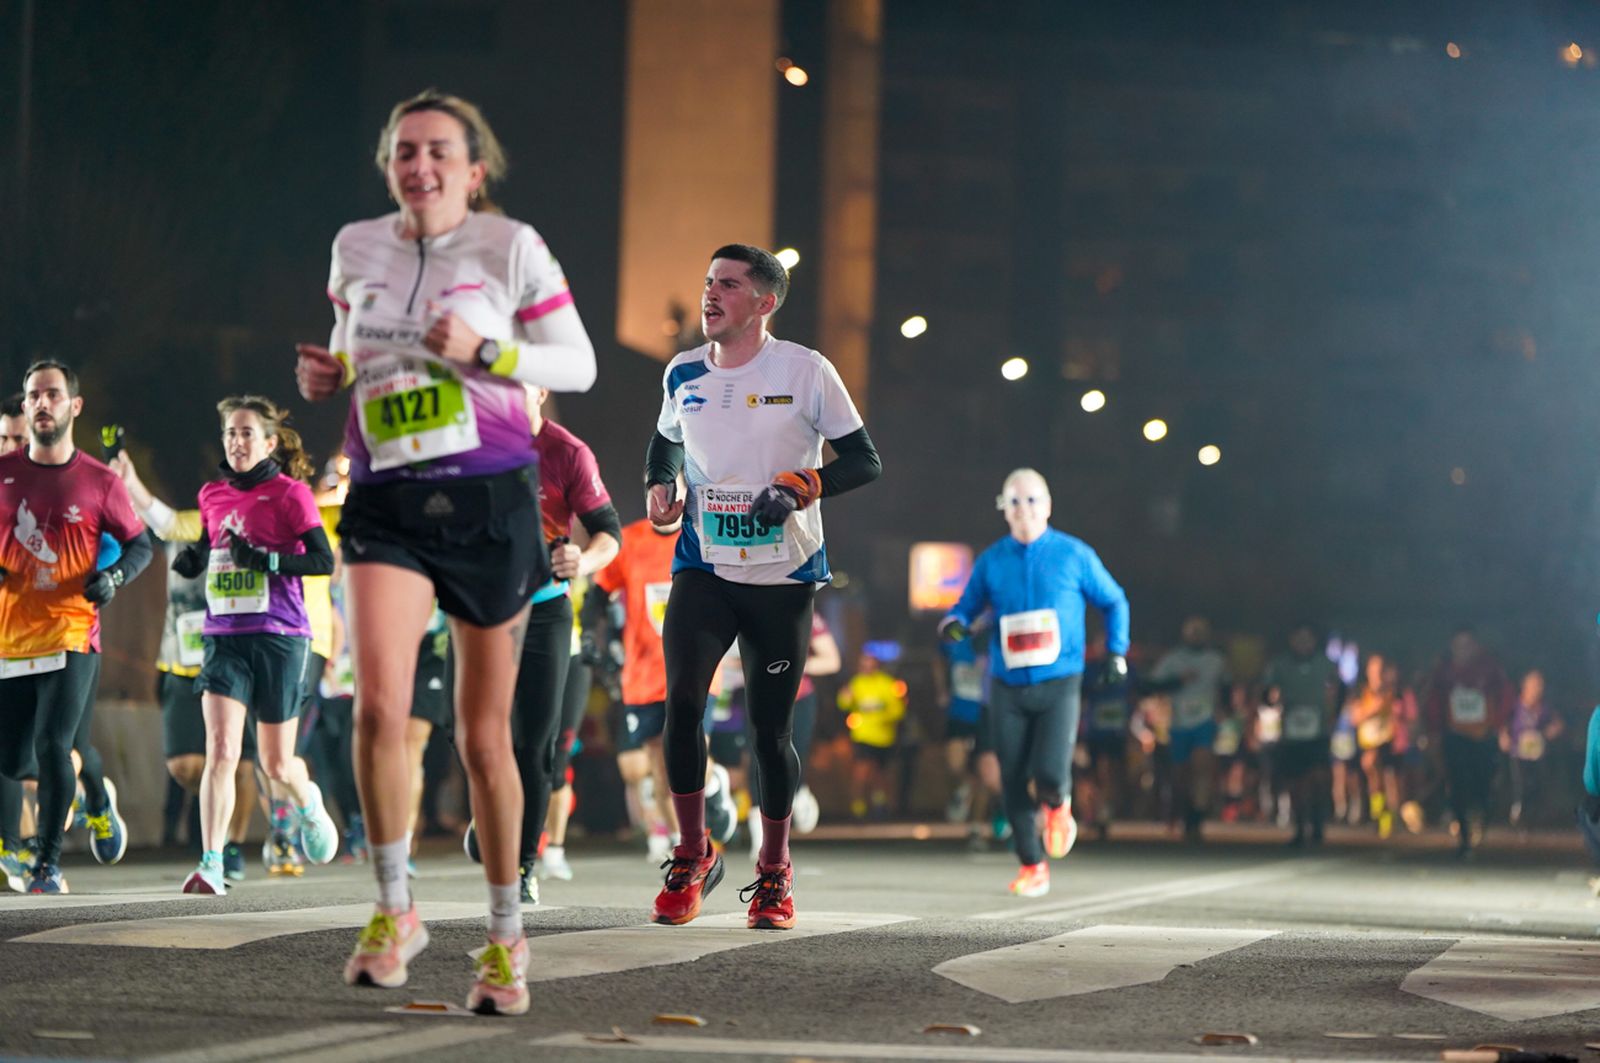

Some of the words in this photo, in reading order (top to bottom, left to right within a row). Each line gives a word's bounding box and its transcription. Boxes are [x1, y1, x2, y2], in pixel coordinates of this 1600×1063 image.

[381, 387, 439, 427] 4127
[715, 494, 741, 503] NOCHE
[742, 494, 753, 503] DE
[707, 502, 723, 512] SAN
[214, 571, 255, 591] 4500
